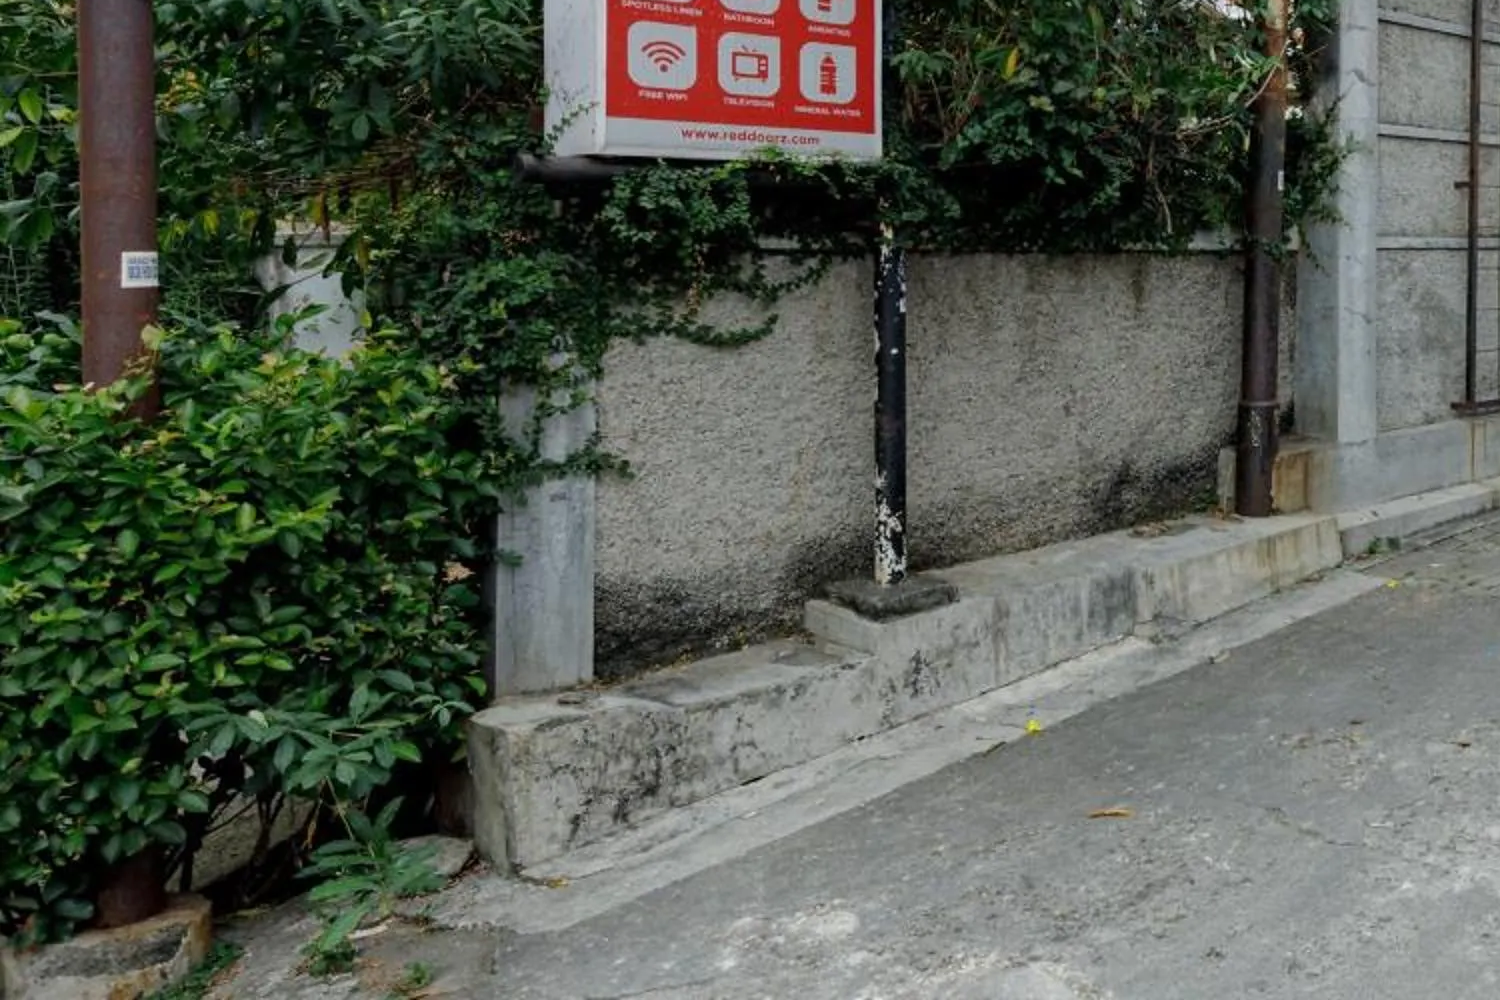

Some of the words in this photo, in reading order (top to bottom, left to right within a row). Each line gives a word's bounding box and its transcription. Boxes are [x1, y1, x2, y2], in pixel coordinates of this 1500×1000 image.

[673, 4, 703, 17] LINEN
[723, 13, 775, 27] BATHROOM
[638, 89, 665, 101] FREE
[723, 96, 775, 109] TELEVISION
[681, 126, 821, 146] www.reddoorz.com
